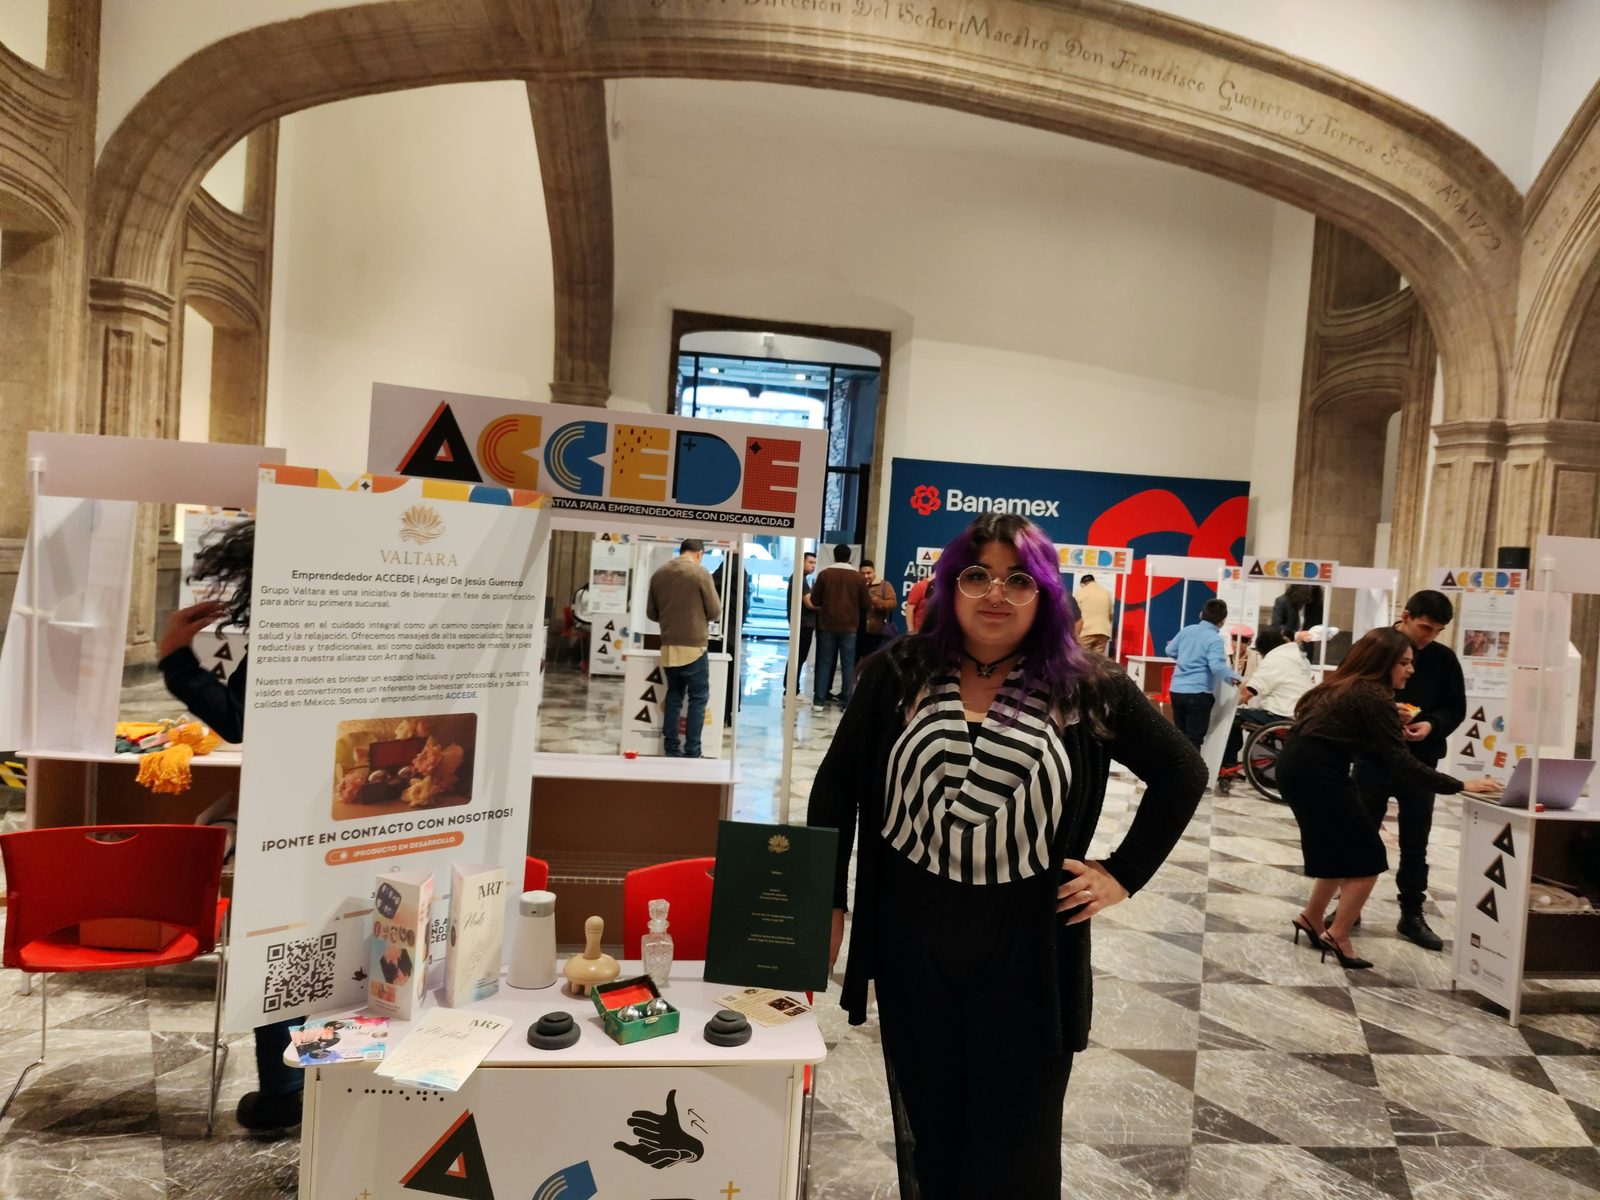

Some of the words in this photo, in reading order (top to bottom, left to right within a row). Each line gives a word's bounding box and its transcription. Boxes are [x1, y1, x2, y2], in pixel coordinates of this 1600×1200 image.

[395, 400, 801, 514] ACCEDE
[946, 489, 1059, 518] Banamex
[552, 498, 578, 509] TIVA
[580, 501, 606, 511] PARA
[608, 504, 694, 519] EMPRENDEDORES
[696, 511, 717, 521] CON
[719, 514, 791, 528] DISCAPACIDAD
[380, 549, 458, 567] VALTARA
[1059, 548, 1126, 568] CCEDE
[1249, 560, 1332, 579] ACCEDE
[292, 570, 372, 582] Emprendededor
[375, 573, 414, 583] ACCEDE
[451, 576, 463, 585] De
[464, 576, 486, 587] Jesús
[489, 577, 523, 587] Guerrero
[1441, 571, 1521, 588] ACCEDE
[261, 585, 289, 596] Grupo
[293, 586, 326, 595] Valtara
[330, 588, 339, 596] es
[400, 590, 411, 598] de
[413, 591, 449, 599] bienestar
[463, 592, 479, 600] fase
[482, 592, 490, 600] de
[260, 599, 281, 607] para
[283, 598, 305, 606] abrir
[320, 599, 353, 608] primera
[259, 620, 300, 629] Creemos
[320, 621, 327, 629] el
[331, 621, 365, 629] cuidado
[369, 621, 400, 631] integral
[441, 621, 467, 629] camino
[471, 621, 503, 631] completo
[259, 631, 284, 640] salud
[286, 633, 291, 641] y
[293, 631, 302, 640] la
[351, 631, 395, 640] Ofrecemos
[398, 633, 429, 641] masajes
[431, 631, 440, 640] de
[442, 632, 457, 640] alta
[257, 642, 305, 652] reductivas
[309, 644, 315, 652] y
[415, 642, 444, 650] cuidado
[447, 642, 475, 651] experto
[477, 641, 486, 649] de
[257, 654, 290, 664] gracias
[301, 654, 334, 662] nuestra
[337, 653, 366, 662] alianza
[368, 653, 383, 661] con
[385, 652, 397, 661] Art
[399, 652, 414, 660] and
[256, 677, 292, 686] Nuestra
[295, 675, 324, 685] misión
[339, 674, 369, 683] brindar
[384, 674, 413, 682] espacio
[416, 671, 448, 680] inclusivo
[255, 687, 281, 697] visión
[285, 688, 295, 696] es
[298, 685, 351, 696] convertirnos
[367, 685, 377, 693] un
[379, 683, 415, 692] referente
[418, 682, 427, 691] de
[430, 681, 464, 691] bienestar
[506, 679, 514, 688] de
[254, 698, 288, 709] calidad
[290, 699, 301, 707] en
[340, 696, 367, 705] Somos
[381, 692, 444, 704] emprendimiento
[319, 832, 336, 845] EN
[341, 821, 413, 842] CONTACTO
[417, 817, 444, 831] CON
[448, 807, 513, 827] NOSOTROS!
[398, 842, 409, 851] EN
[478, 881, 503, 899] ART
